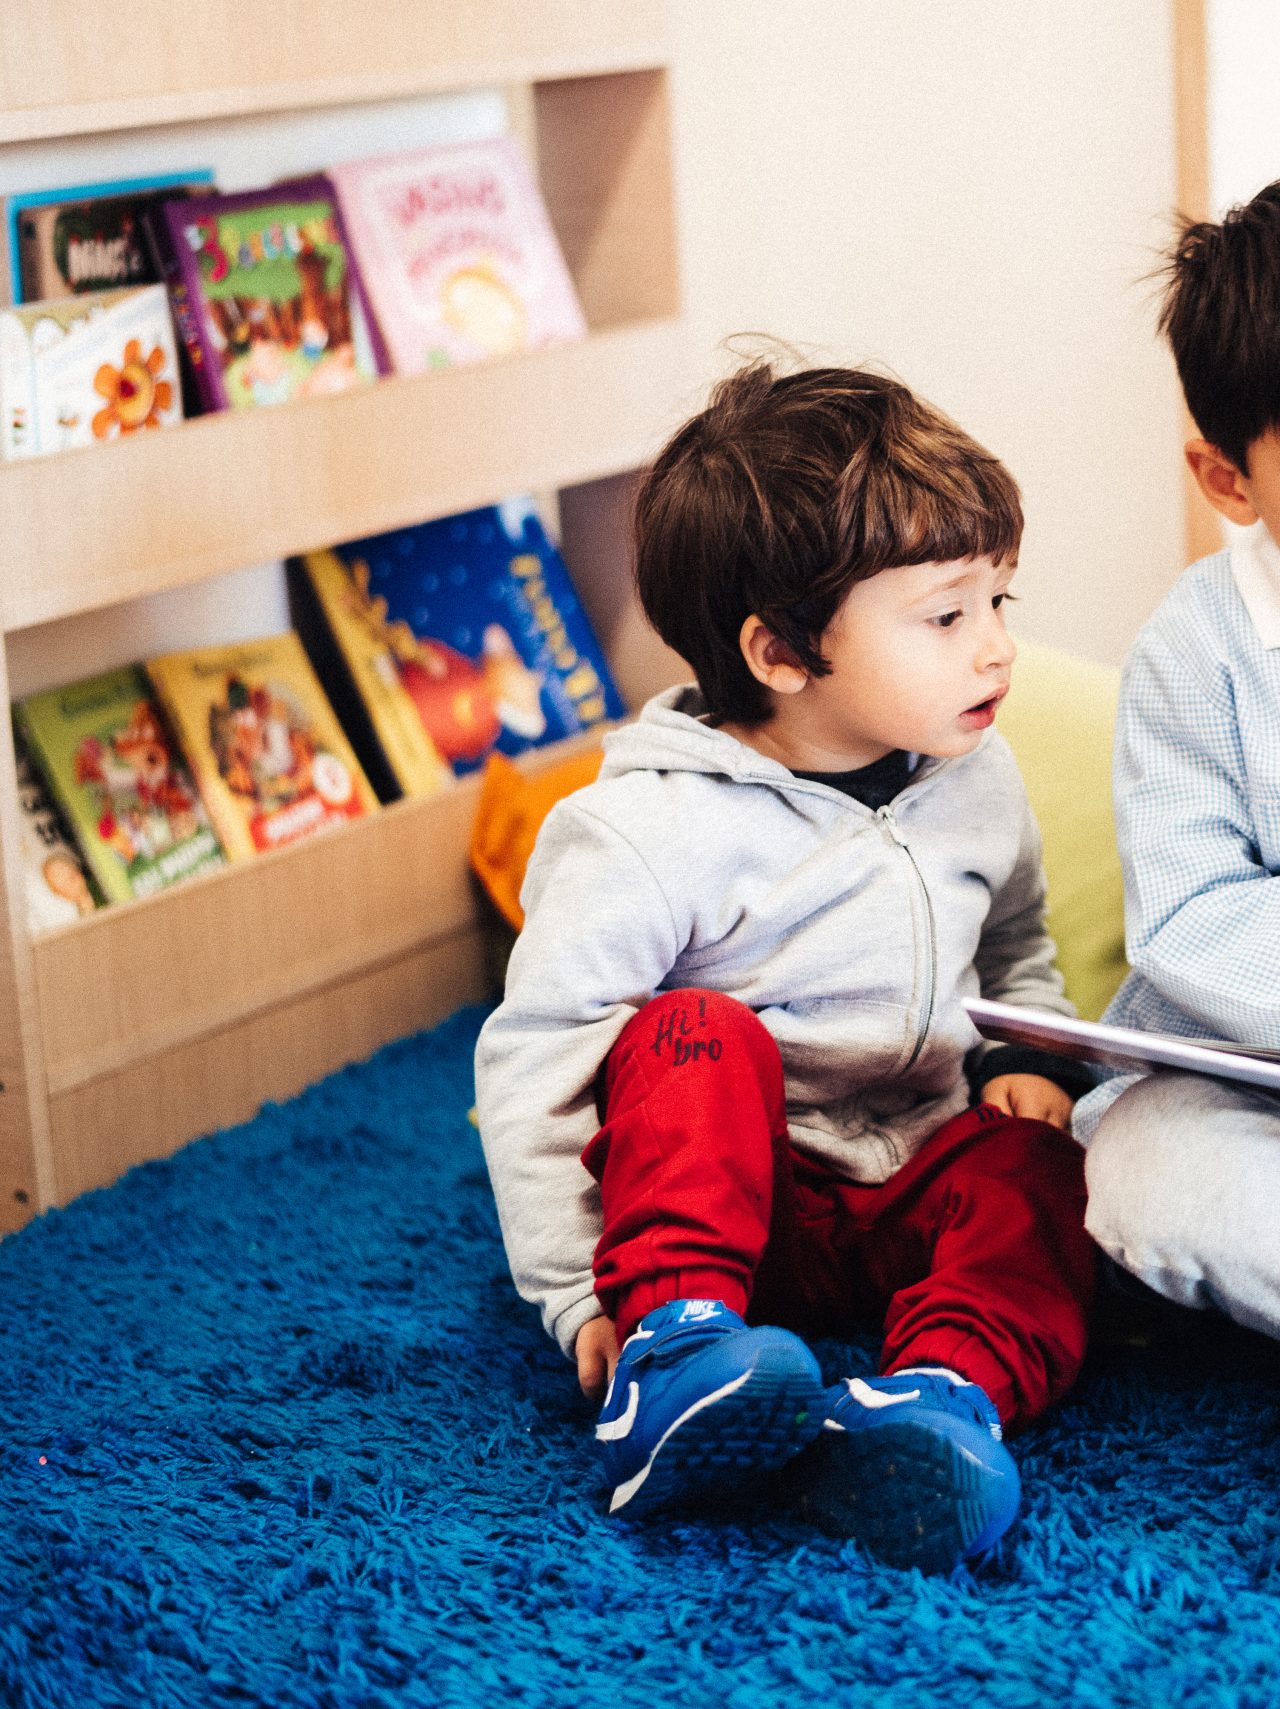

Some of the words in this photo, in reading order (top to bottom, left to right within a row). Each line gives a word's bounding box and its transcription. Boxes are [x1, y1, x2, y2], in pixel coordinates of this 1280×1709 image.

[651, 997, 705, 1055] Hi!
[673, 1037, 722, 1066] bro
[685, 1300, 716, 1315] NIKE
